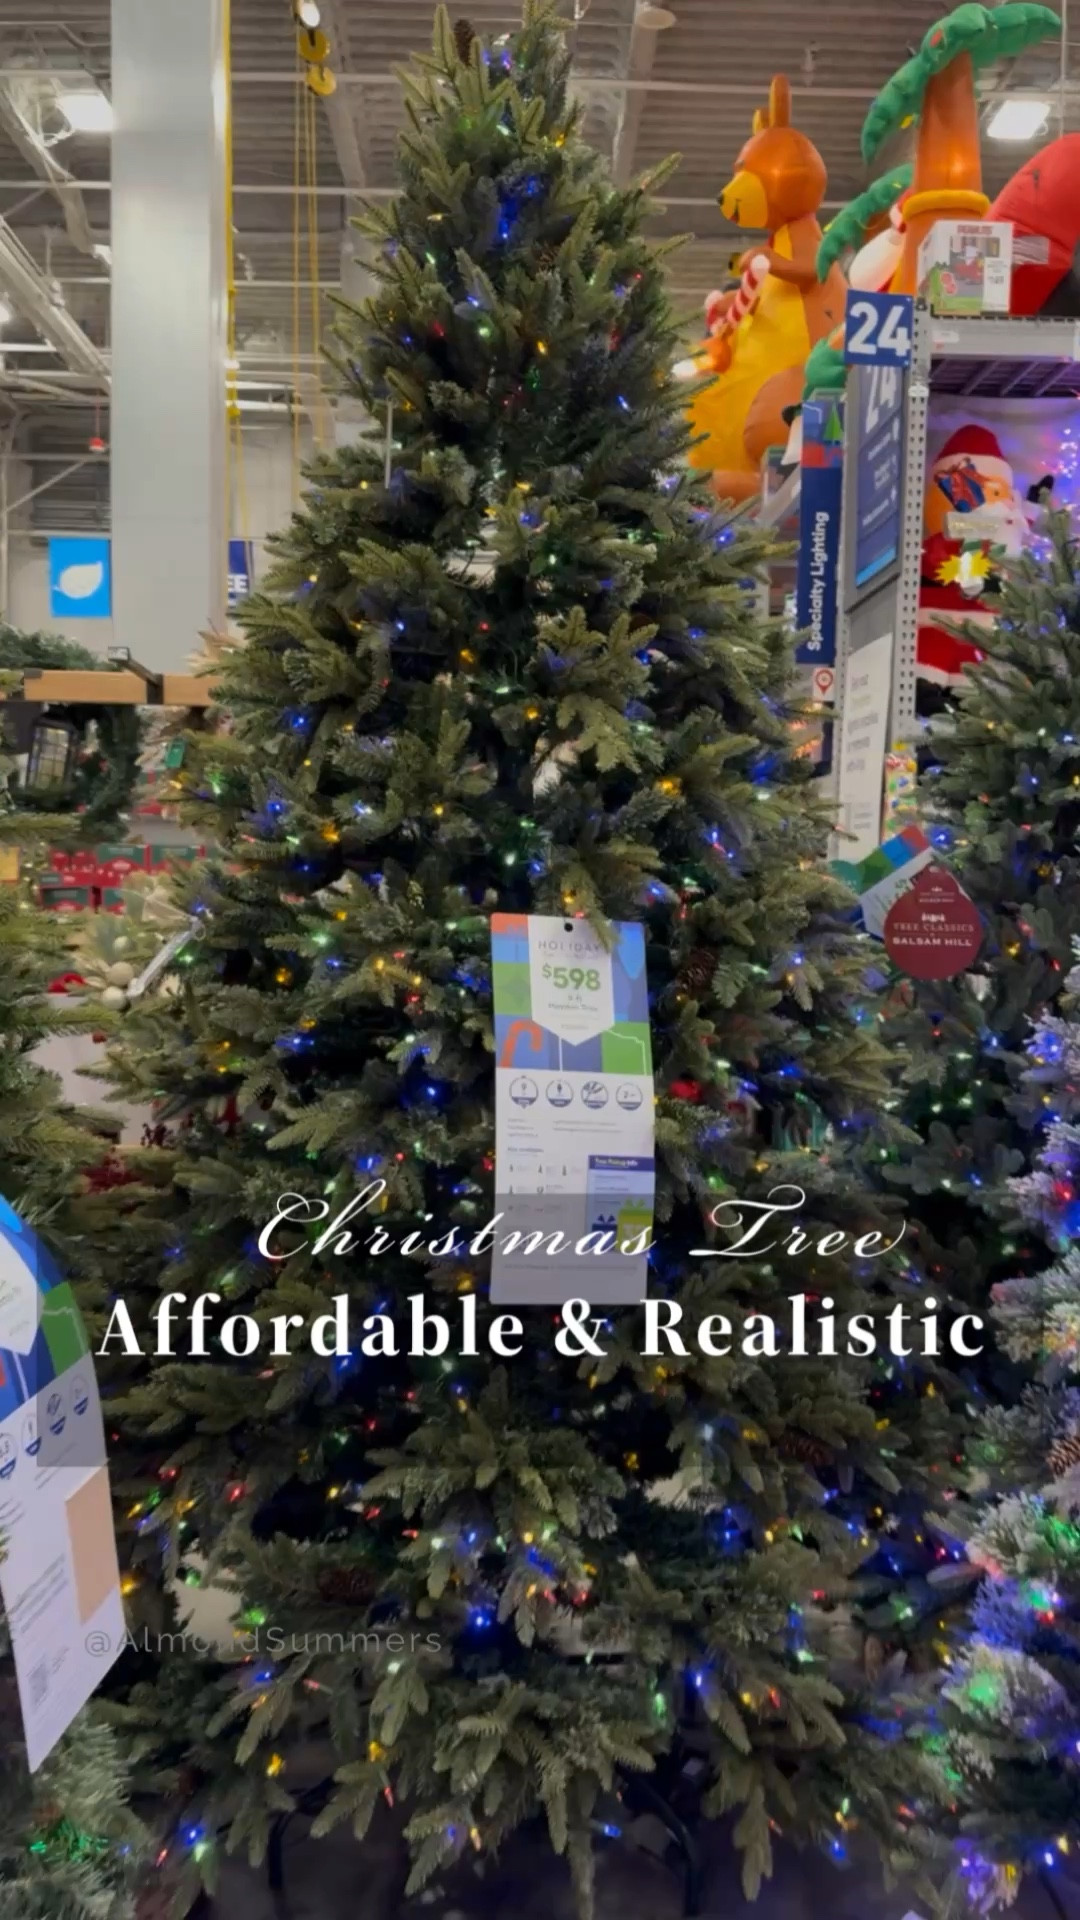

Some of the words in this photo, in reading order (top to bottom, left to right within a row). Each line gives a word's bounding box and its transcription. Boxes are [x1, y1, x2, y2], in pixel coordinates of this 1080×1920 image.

[848, 301, 911, 356] 24
[810, 511, 829, 575] Lighting
[807, 578, 826, 651] Specialty
[892, 937, 941, 946] BALSAM
[944, 939, 973, 948] HILL
[542, 963, 601, 991] $598
